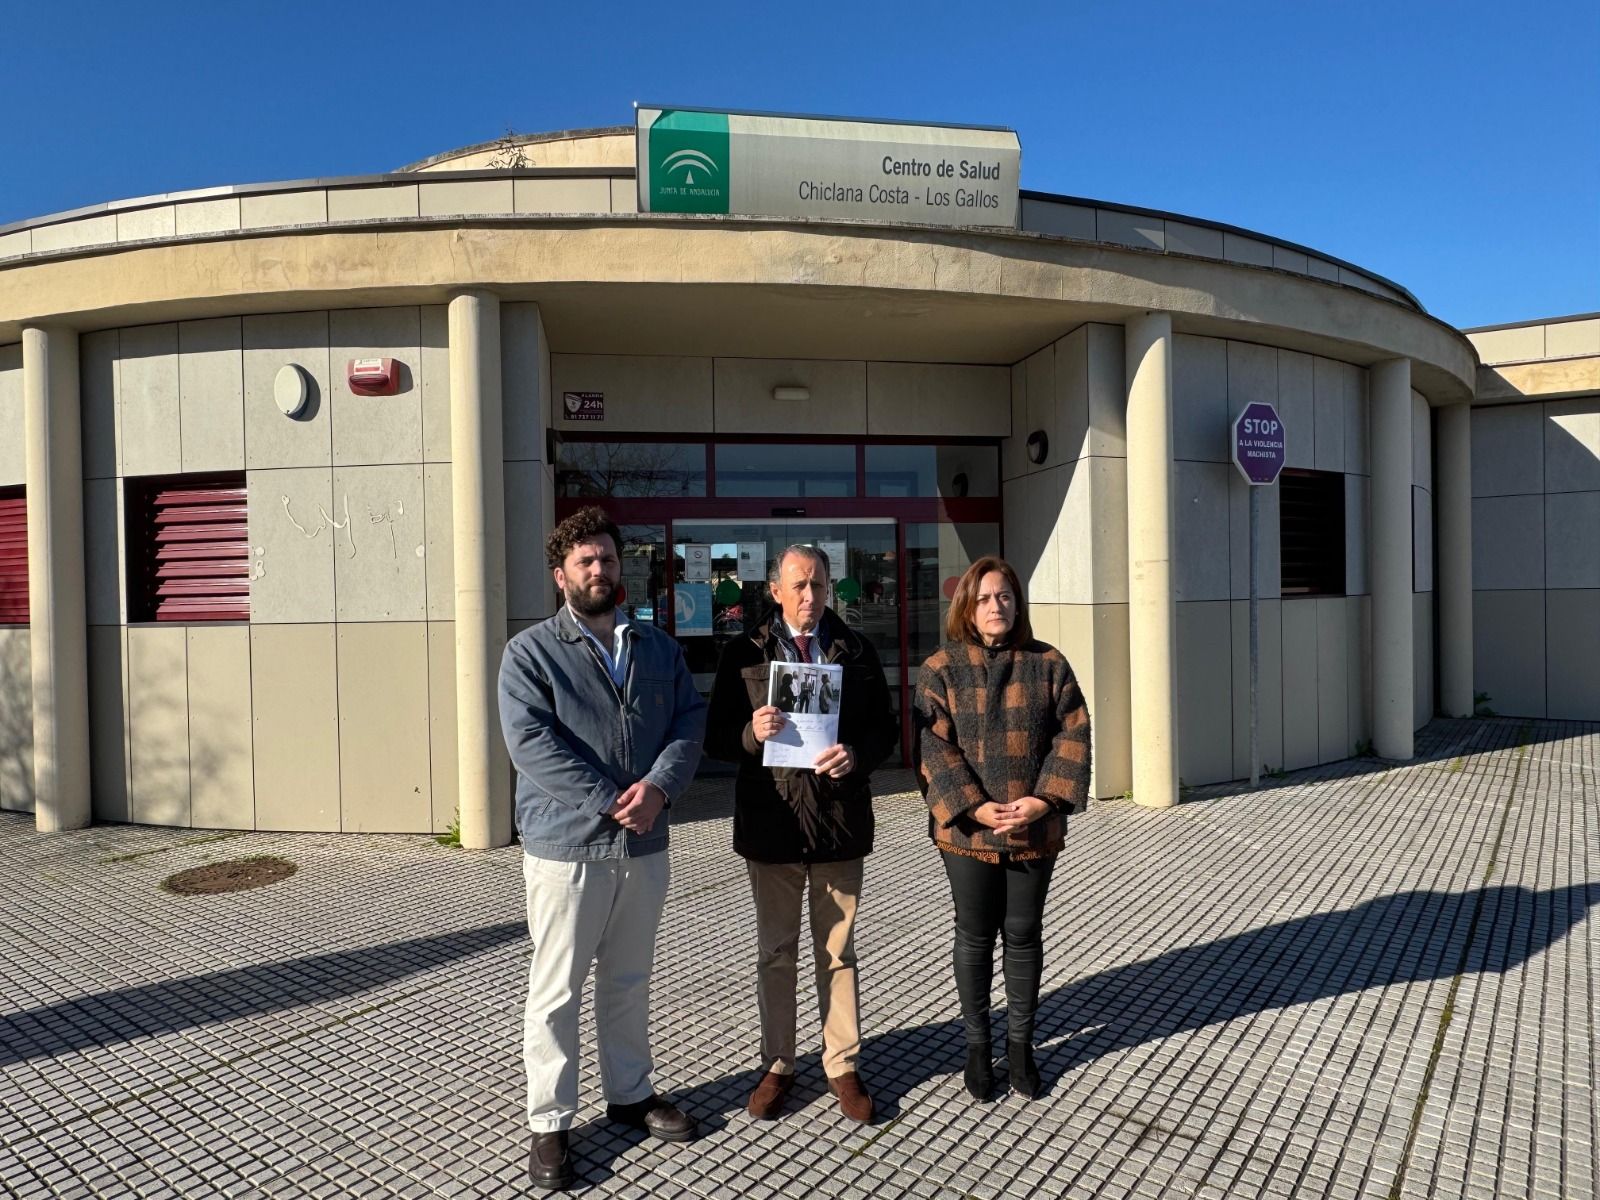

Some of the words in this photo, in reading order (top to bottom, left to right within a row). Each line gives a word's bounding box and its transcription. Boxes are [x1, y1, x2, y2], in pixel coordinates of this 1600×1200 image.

[882, 156, 931, 177] Centro
[936, 158, 954, 177] de
[959, 161, 1000, 180] Salud
[659, 187, 678, 195] JUNTA
[799, 181, 863, 203] Chiclana
[869, 184, 909, 204] Costa
[926, 187, 950, 207] Los
[955, 189, 999, 209] Gallos
[584, 400, 603, 409] 24h
[1244, 418, 1278, 435] STOP
[1254, 440, 1283, 448] VIOLENCIA
